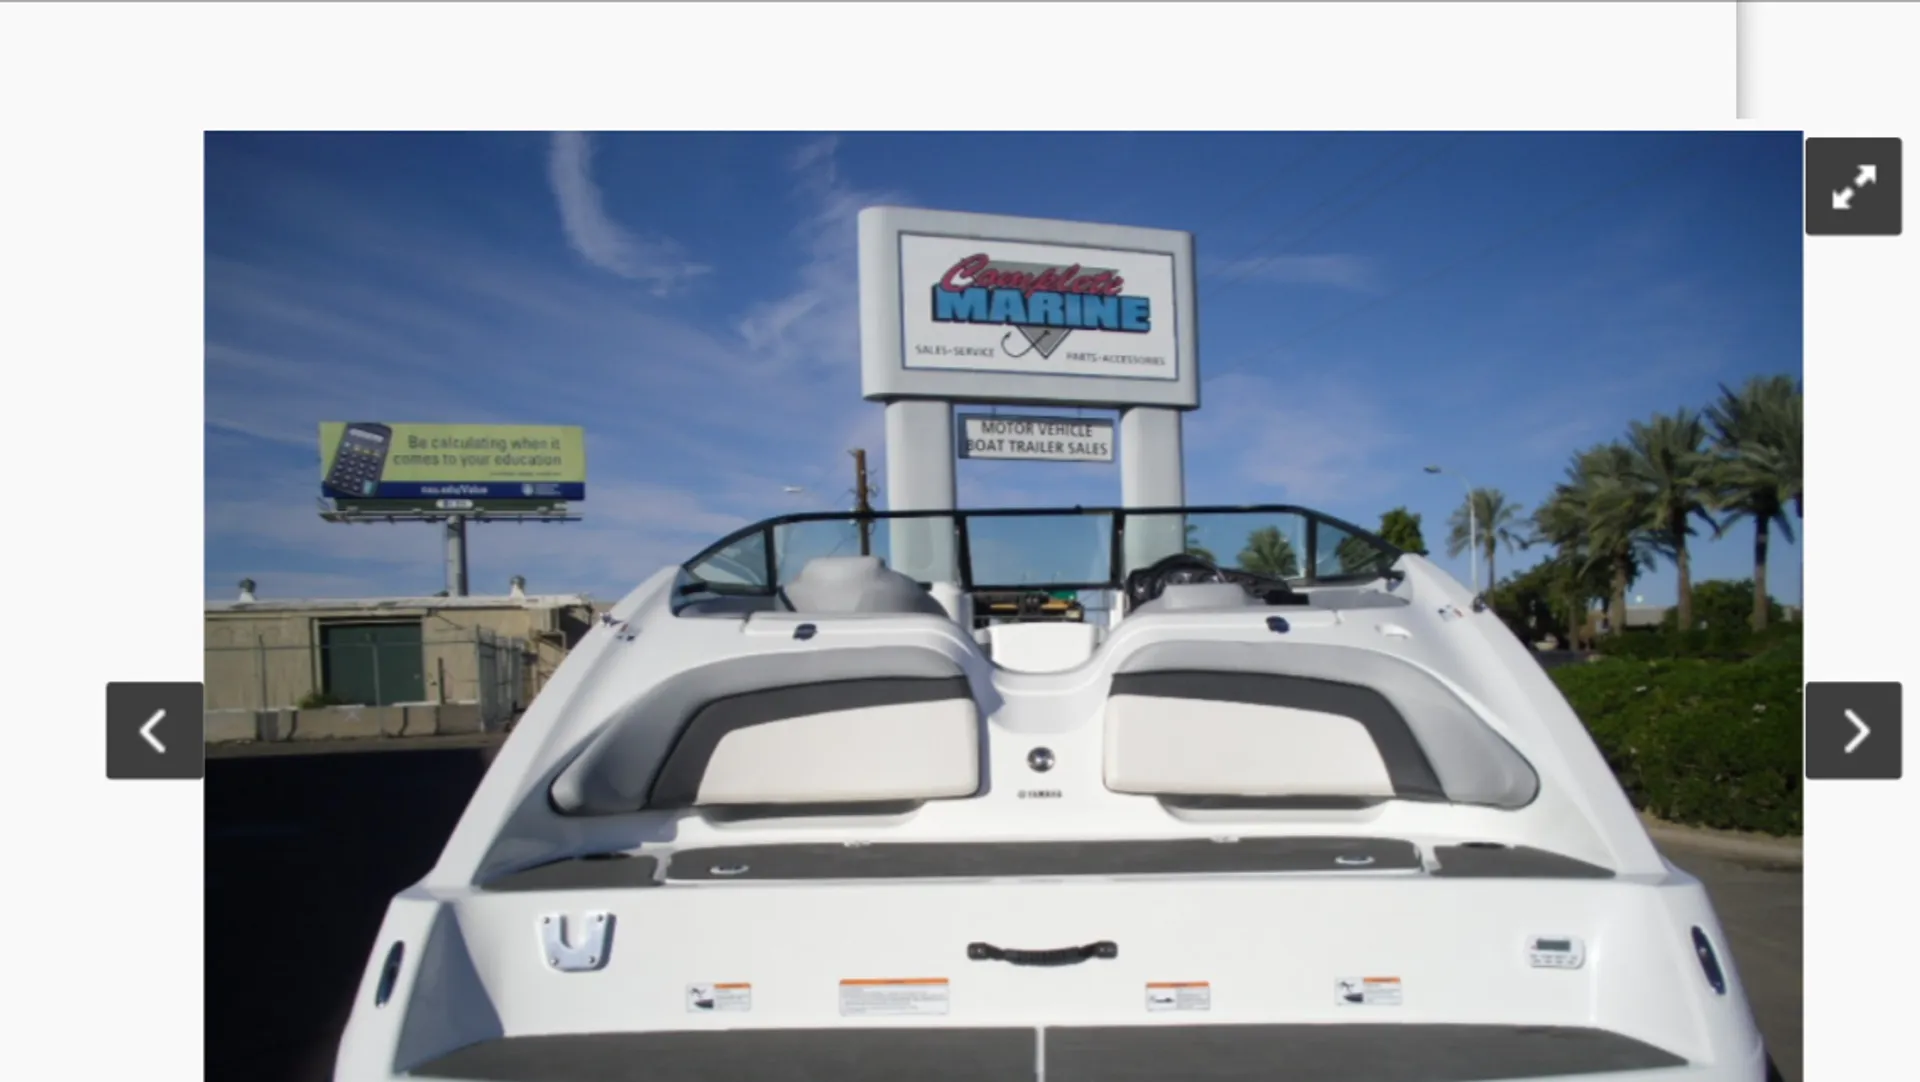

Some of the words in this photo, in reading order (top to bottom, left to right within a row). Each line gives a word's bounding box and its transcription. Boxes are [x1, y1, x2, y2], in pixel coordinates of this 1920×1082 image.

[939, 253, 1124, 297] Complete
[931, 284, 1151, 333] MARINE
[981, 421, 1034, 436] MOTOR
[1037, 424, 1093, 438] VEHICLE
[408, 435, 428, 449] Be
[431, 437, 507, 451] calculating
[511, 437, 547, 450] when
[551, 437, 561, 450] it
[967, 439, 1005, 451] BOAT
[1009, 440, 1064, 453] TRAILER
[1068, 442, 1108, 455] SALES
[393, 454, 439, 466] comes
[443, 454, 457, 466] to
[460, 454, 491, 468] your
[494, 454, 562, 466] education
